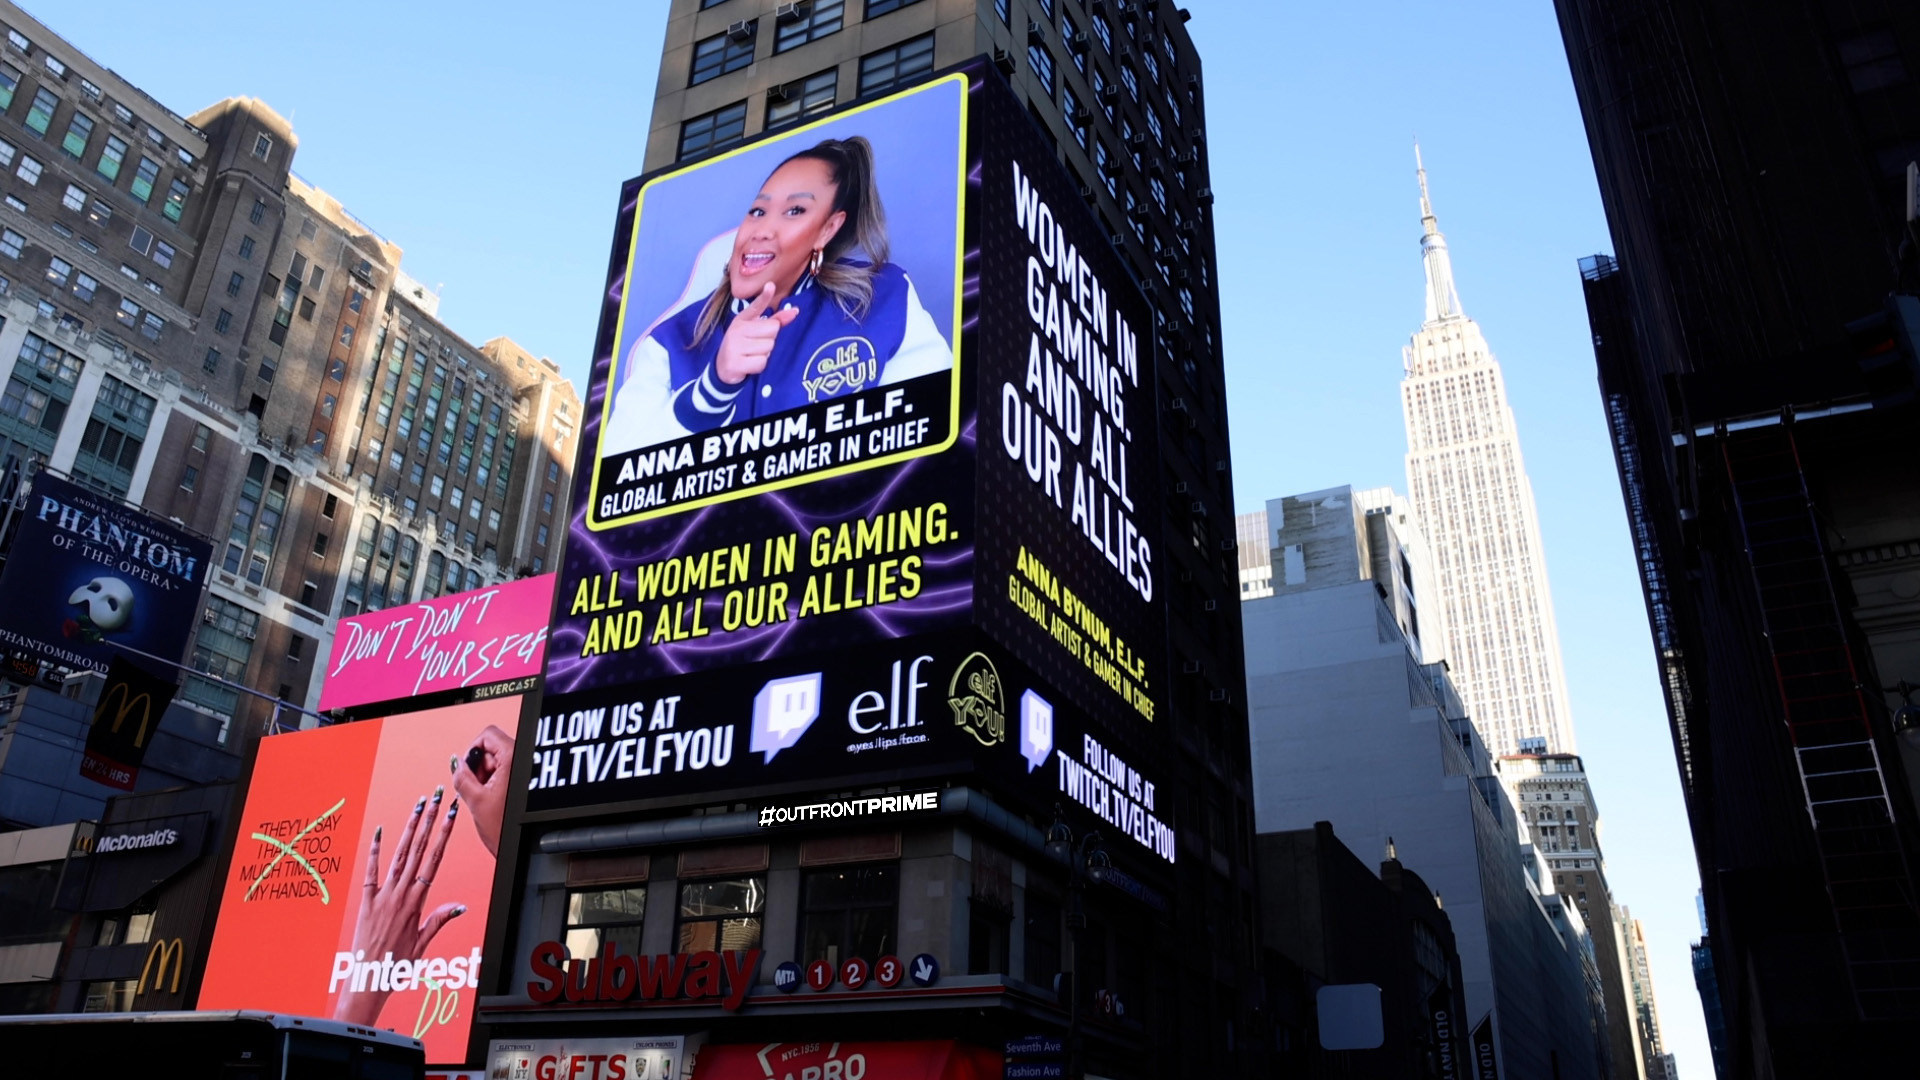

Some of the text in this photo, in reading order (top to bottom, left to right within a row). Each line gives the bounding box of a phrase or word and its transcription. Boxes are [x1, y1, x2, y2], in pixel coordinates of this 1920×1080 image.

[1013, 160, 1138, 388] WOMEN IN
[1027, 255, 1131, 442] GAMING.
[616, 388, 913, 485] ANNA BYNUM, E.L.F.
[1026, 332, 1134, 512] AND ALL
[600, 417, 929, 518] GLOBAL ARTIST & GAMER IN CHIEF
[1002, 381, 1152, 602] OUR ALLIES
[36, 495, 197, 581] PHANTOM
[74, 496, 107, 513] ANDREW
[110, 512, 137, 528] LLOYD
[53, 534, 171, 590] OF THE OPERA
[570, 502, 959, 616] ALL WOMEN IN GAMING.
[331, 590, 499, 677] DON'T DON'T
[581, 555, 923, 658] AND ALL OUR ALLIES
[1017, 545, 1149, 689] ANNA BYNUM, E.L.F.
[412, 626, 549, 696] YOURSELF
[1009, 574, 1154, 722] GLOBAL ARTIST & GAMER IN CHIEF
[475, 677, 536, 699] SILVERCAST
[610, 701, 644, 736] US
[648, 695, 681, 731] AT
[108, 768, 131, 784] HRS
[1084, 733, 1155, 812] FOLLOW US AT
[314, 814, 342, 833] SAY
[758, 792, 938, 827] #OUTFRONTPRIME
[1057, 749, 1175, 864] TWITCH.TV/ELFYOU
[96, 829, 179, 853] McDonald's
[240, 856, 341, 882] MUCH TIME ON
[264, 842, 299, 859] HAE
[302, 836, 331, 855] TOO
[248, 884, 269, 901] MY
[328, 947, 482, 994] Pinterest
[527, 940, 895, 1011] Subway MTA 1 2 3
[1006, 1042, 1061, 1053] Seventh Ave
[1434, 1010, 1449, 1039] OLD
[1480, 1043, 1494, 1068] OLD
[1007, 1065, 1061, 1077] Fashion Ave
